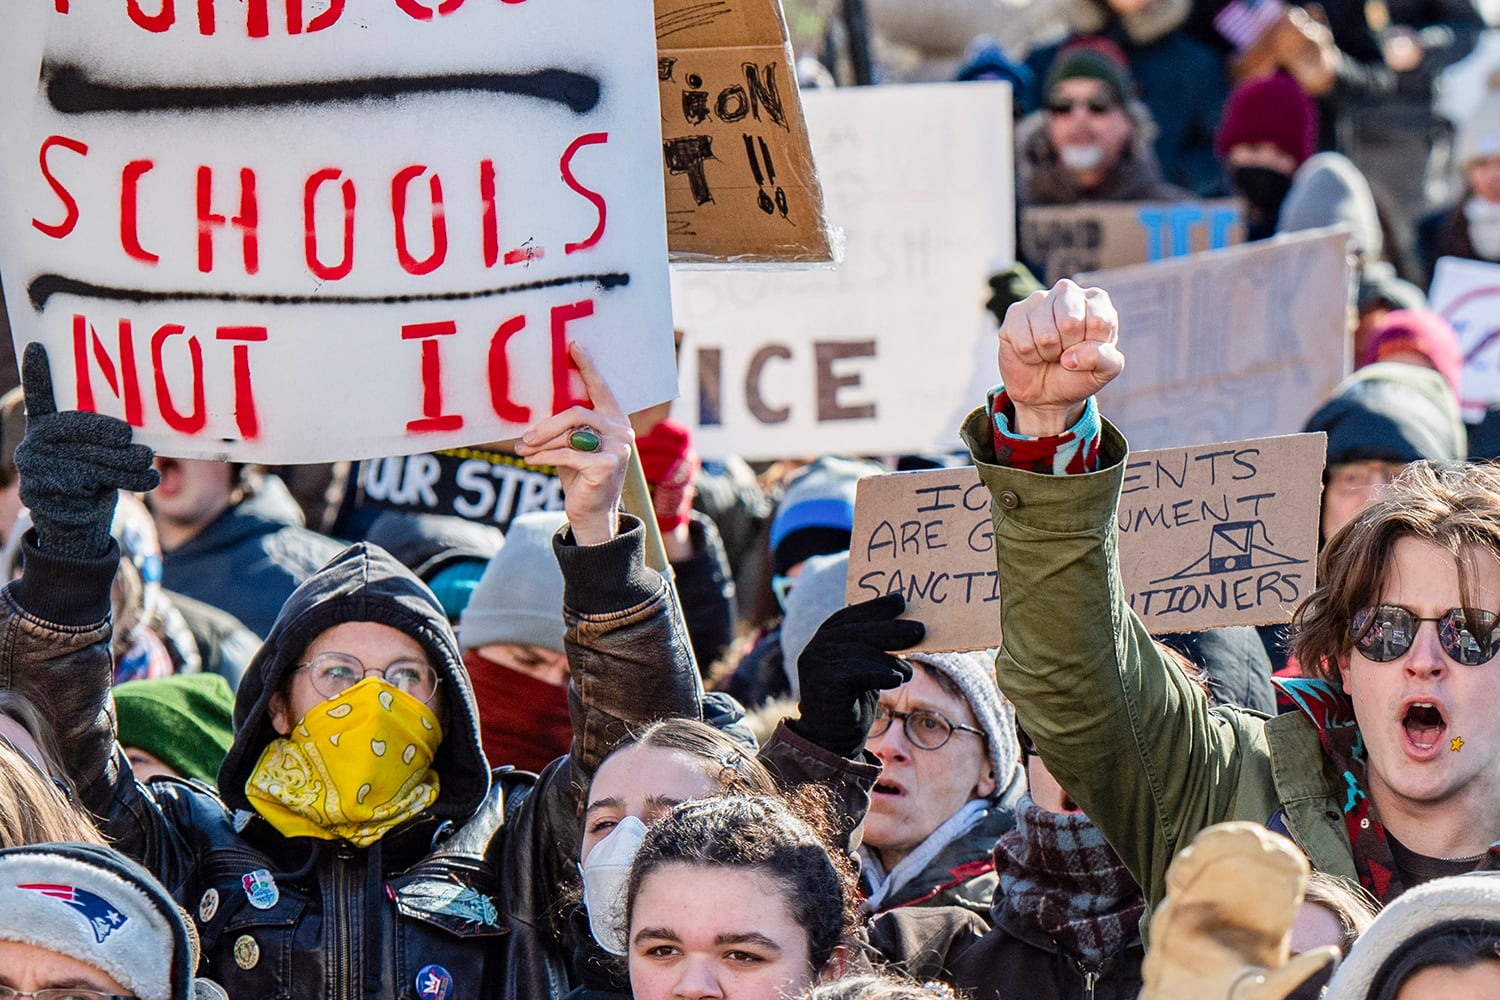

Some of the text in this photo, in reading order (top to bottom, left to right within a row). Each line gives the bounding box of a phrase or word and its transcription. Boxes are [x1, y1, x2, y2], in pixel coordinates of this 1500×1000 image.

[31, 131, 609, 281] SCHOOLS
[72, 300, 595, 439] NOT ICE
[915, 449, 1261, 513] IC ENTS
[867, 519, 948, 563] ARE
[858, 569, 1302, 617] SANCTI TIONERS
